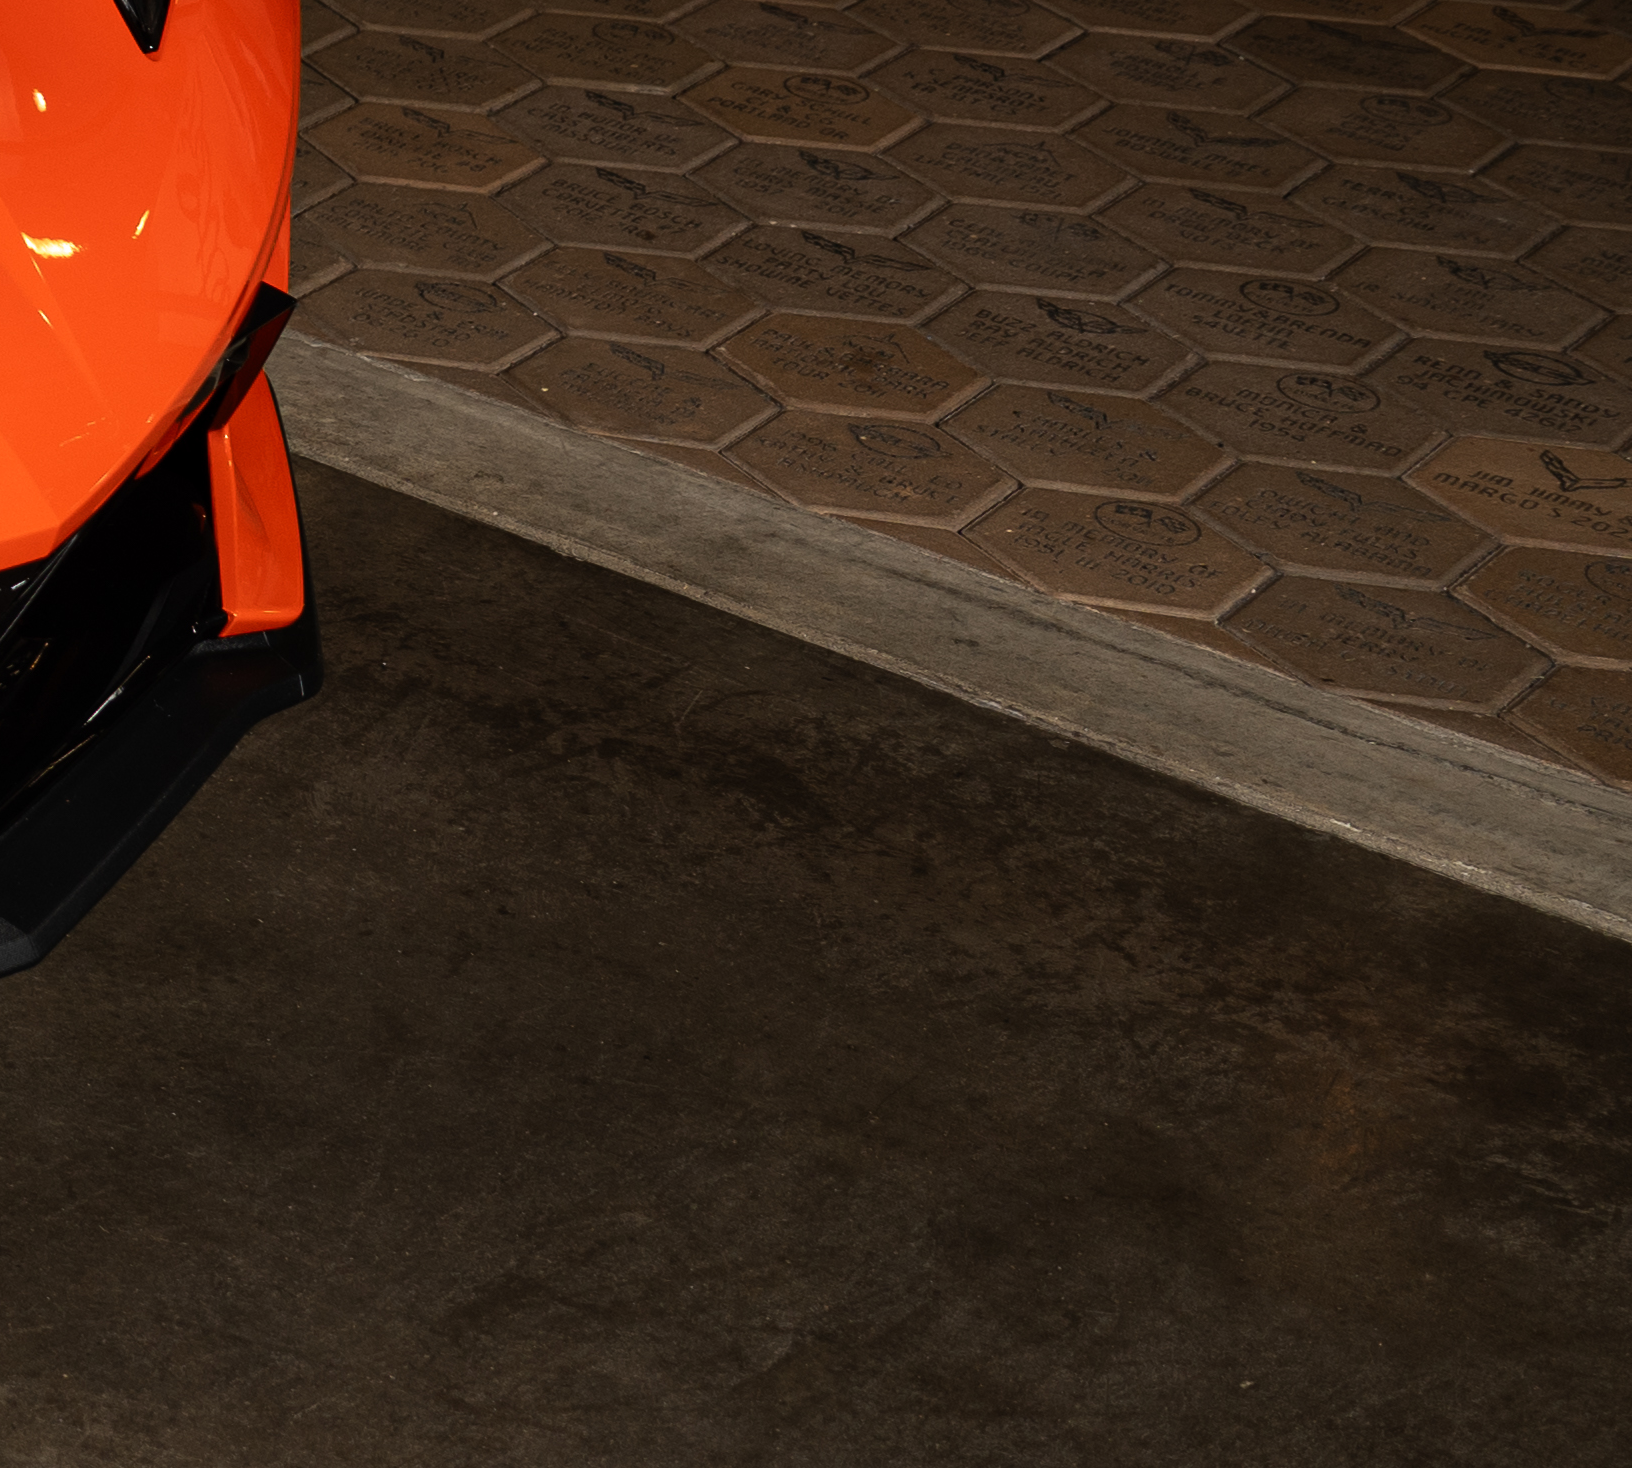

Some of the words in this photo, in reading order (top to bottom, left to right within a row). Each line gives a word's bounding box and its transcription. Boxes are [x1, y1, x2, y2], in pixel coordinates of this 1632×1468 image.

[726, 81, 792, 101] GARY
[522, 107, 585, 127] CASS
[584, 125, 683, 156] ROBERTS
[574, 110, 650, 135] HONOR
[654, 133, 683, 144] OF
[704, 95, 814, 129] PORTLAND
[815, 126, 852, 139] OR
[342, 126, 447, 159] CORVETTE
[538, 123, 644, 156] MISSOURI
[729, 166, 799, 188] CHRIS
[768, 165, 868, 196] MEMORY
[1337, 179, 1414, 203] TERRY
[536, 187, 650, 224] CORVETTE
[547, 178, 624, 204] BRUCE
[625, 201, 706, 229] BOSCH
[1173, 206, 1279, 238] MEMORY
[324, 204, 436, 241] CORVETTE
[438, 239, 501, 262] CLUB
[739, 238, 824, 266] LOVING
[828, 264, 934, 299] MEMORY
[761, 256, 834, 281] PATTY
[838, 279, 888, 297] LOU
[820, 286, 909, 317] VETTES
[1160, 283, 1374, 348] TOMMY&BRENDA
[972, 308, 1040, 332] BUZZ
[1043, 330, 1152, 366] ALDRICH
[1209, 309, 1296, 338] LOFTIN
[952, 328, 1010, 349] JEFF
[1014, 347, 1121, 383] ALDRICH
[965, 319, 1017, 338] RAY
[1026, 337, 1132, 373] ALDRICH
[768, 357, 832, 381] TOUR
[1182, 386, 1272, 417] BRUCE
[1439, 388, 1496, 409] CPE
[1501, 406, 1584, 434] 42612
[1492, 378, 1520, 390] &
[1526, 387, 1623, 420] SANDY
[1347, 422, 1372, 434] &
[1430, 472, 1542, 511] MARGO
[1524, 486, 1614, 517] JIMMY
[1019, 508, 1051, 523] IN
[1057, 520, 1181, 565] MEMORY
[1185, 562, 1221, 578] OF
[1296, 529, 1434, 577] ALABAMA
[1102, 550, 1203, 588] HARRIS
[1110, 567, 1180, 596] 2010
[1318, 611, 1445, 658] MEMORY
[1329, 630, 1419, 665] JERRY
